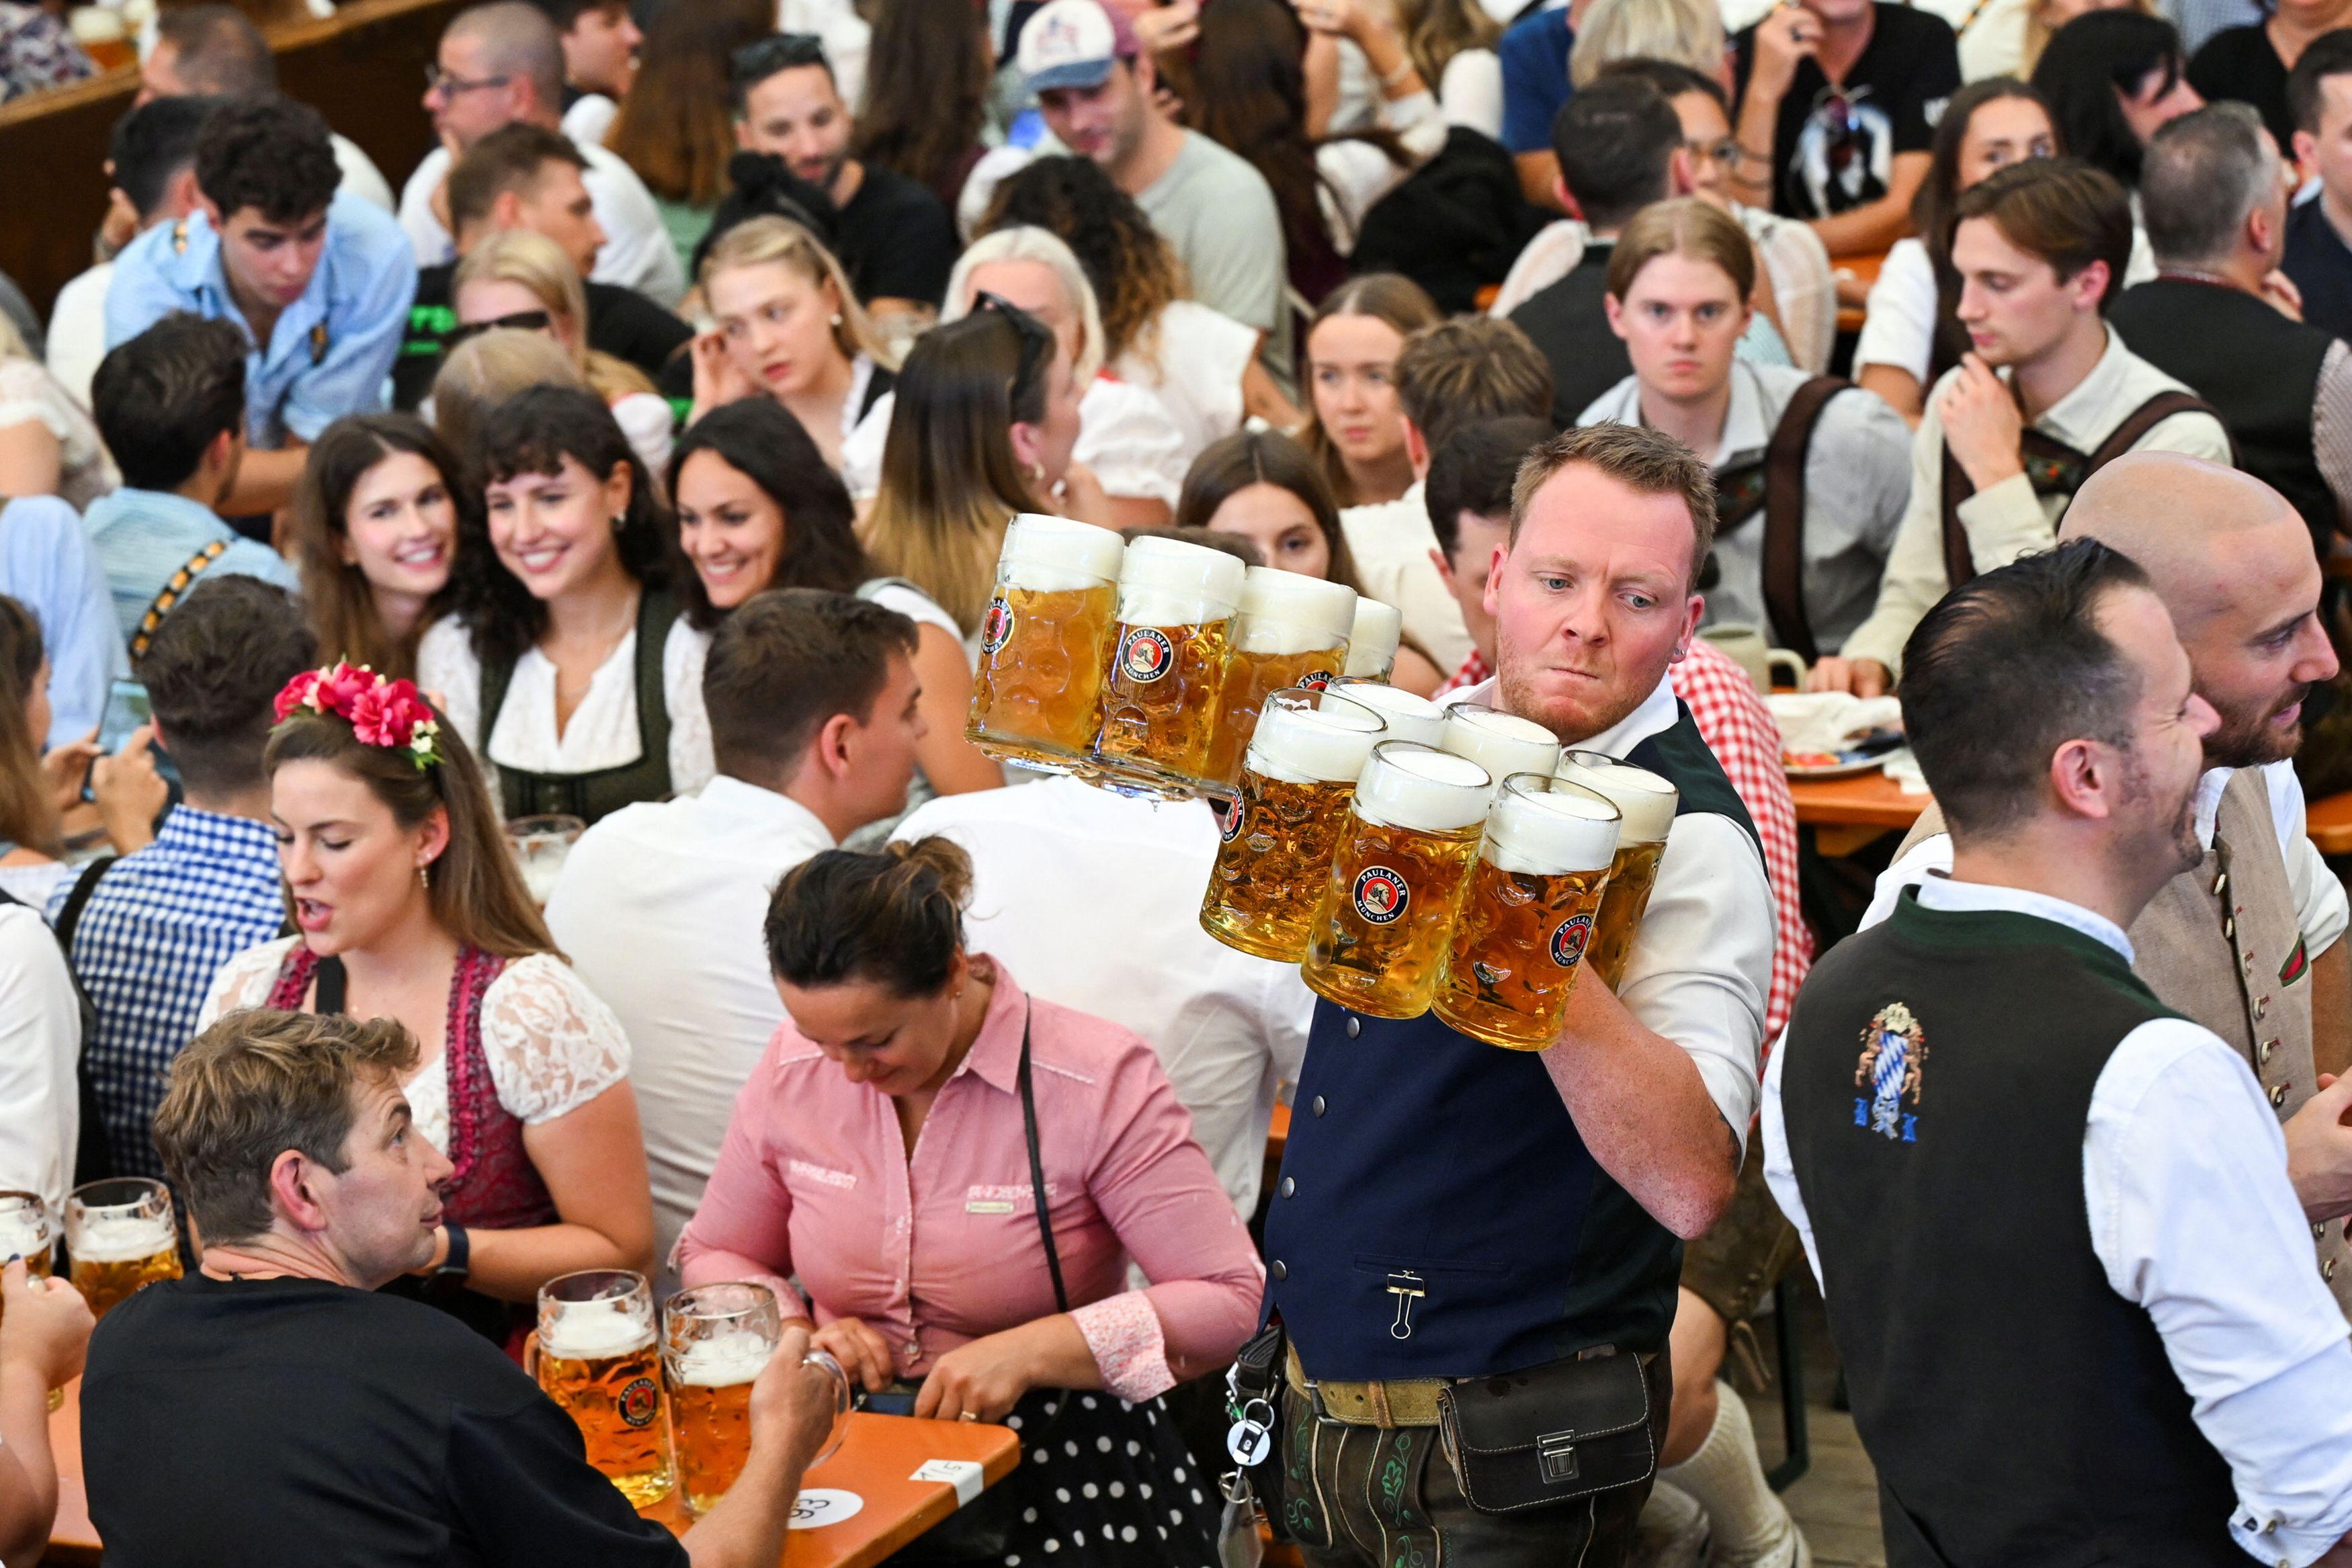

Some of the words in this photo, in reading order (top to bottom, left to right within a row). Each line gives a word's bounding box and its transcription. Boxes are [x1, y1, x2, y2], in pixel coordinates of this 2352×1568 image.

[1127, 630, 1170, 654] PAULANER
[1299, 672, 1329, 689] PAULA
[1360, 869, 1406, 897] PAULANER
